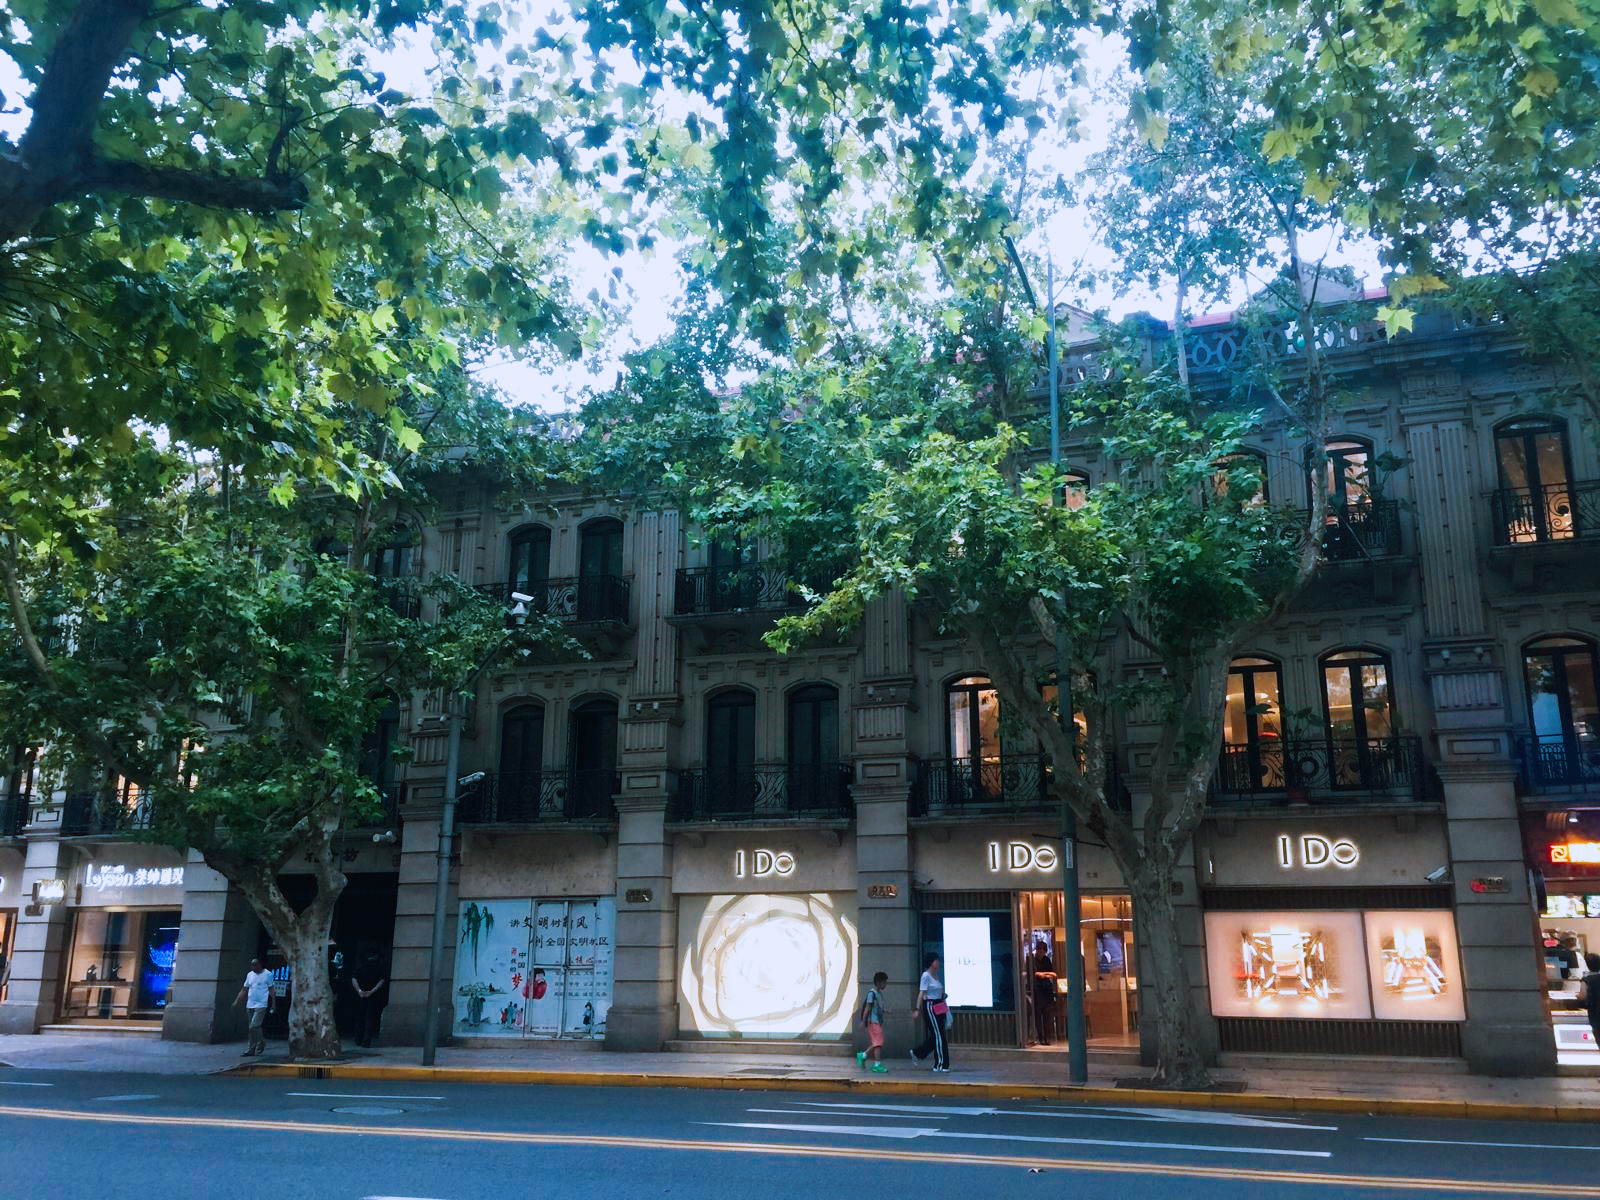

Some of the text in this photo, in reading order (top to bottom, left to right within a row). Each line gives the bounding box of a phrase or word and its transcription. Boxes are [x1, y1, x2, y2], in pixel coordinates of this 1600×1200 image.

[735, 849, 795, 878] I Do
[989, 842, 999, 872] I
[1008, 842, 1057, 872] Do
[1278, 834, 1358, 868] I Do
